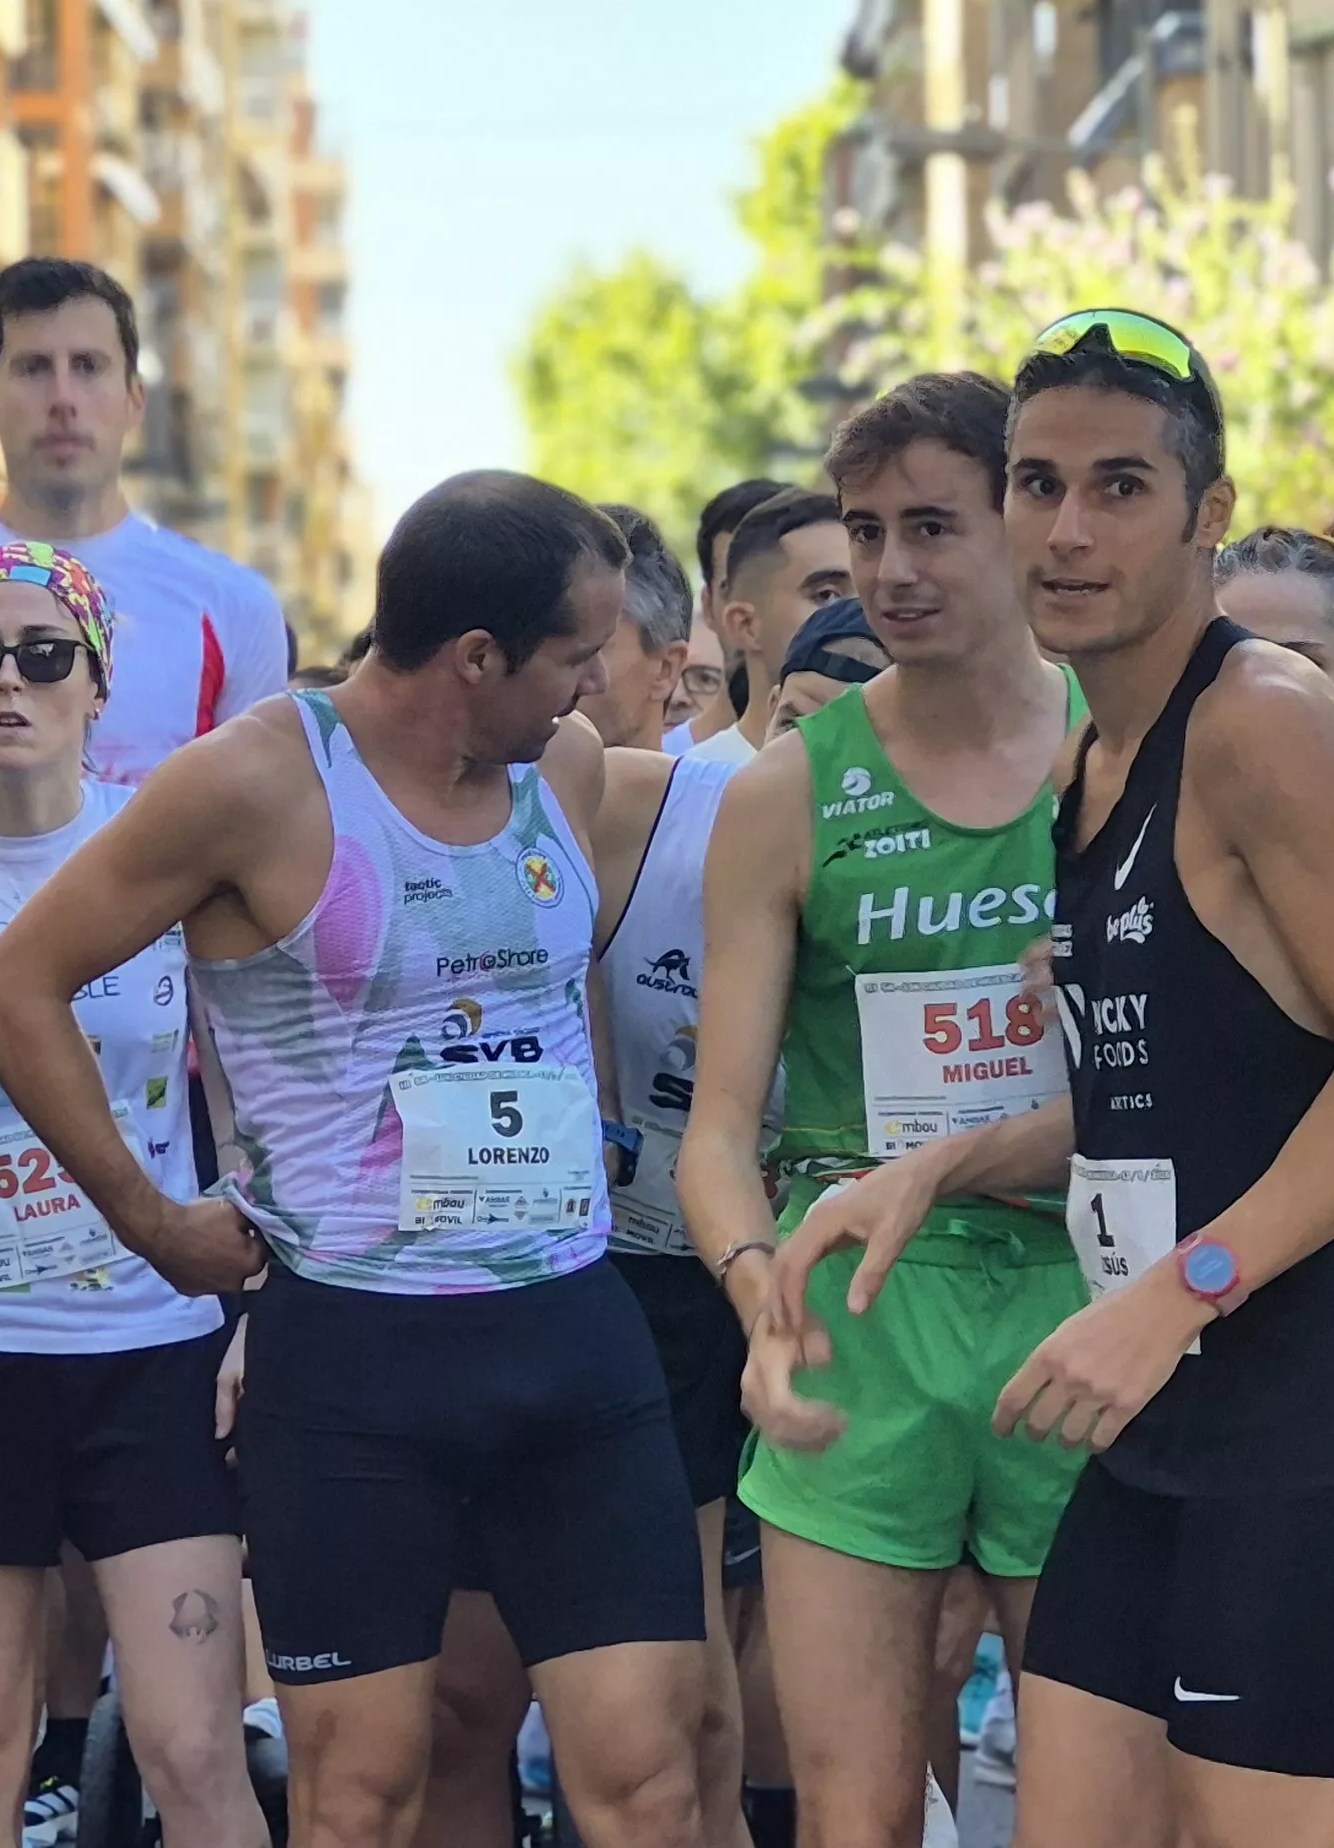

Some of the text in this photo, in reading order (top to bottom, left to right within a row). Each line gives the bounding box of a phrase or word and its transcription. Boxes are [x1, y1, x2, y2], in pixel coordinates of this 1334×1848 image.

[822, 791, 895, 820] VIATOR
[864, 828, 931, 859] ZOITI
[405, 877, 442, 892] tactic
[436, 948, 549, 976] PetroShore
[923, 994, 1045, 1054] 518
[942, 1056, 1034, 1084] MIGUEL
[489, 1090, 524, 1138] 5
[468, 1146, 551, 1165] LORENZO
[14, 1194, 82, 1222] LAURA
[1090, 1193, 1116, 1248] 1
[1101, 1252, 1129, 1277] SÚS
